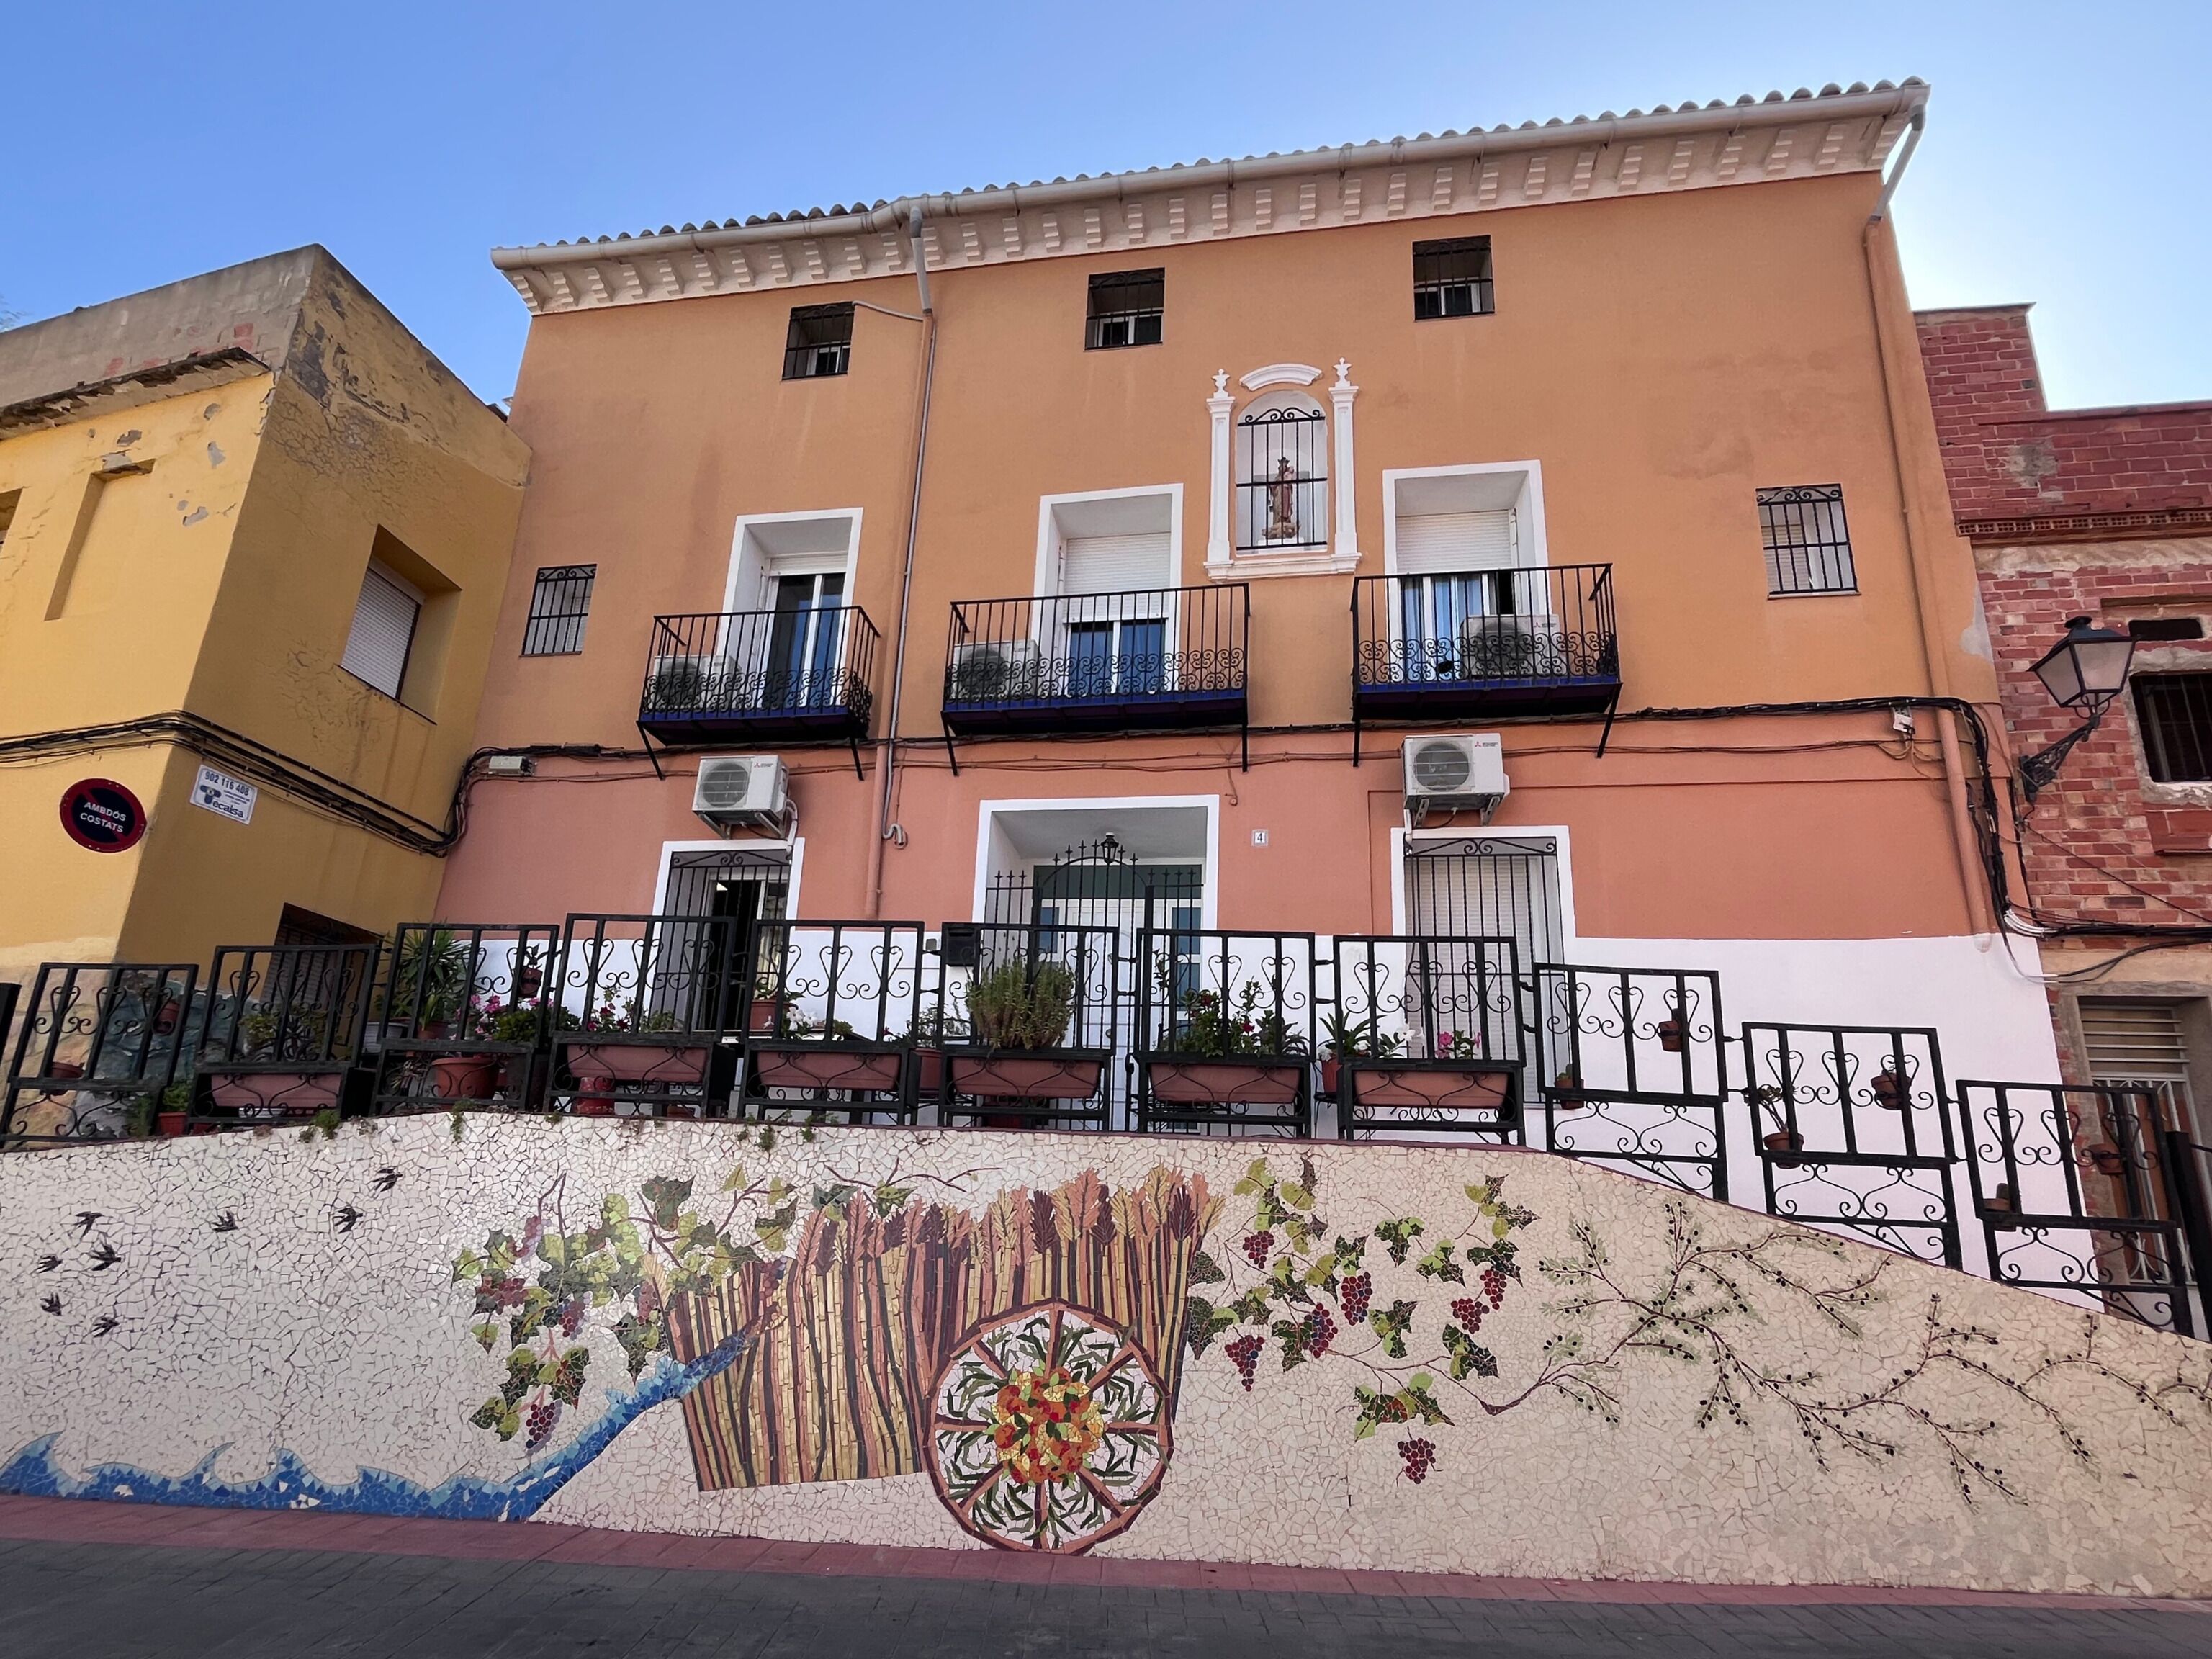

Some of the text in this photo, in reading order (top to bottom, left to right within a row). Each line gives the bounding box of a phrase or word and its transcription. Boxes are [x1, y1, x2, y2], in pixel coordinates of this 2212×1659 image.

[204, 771, 220, 783] 902
[221, 778, 235, 790] 116
[84, 801, 127, 822] AMBDÓS
[80, 812, 123, 832] COSTATS
[1257, 832, 1262, 842] 4
